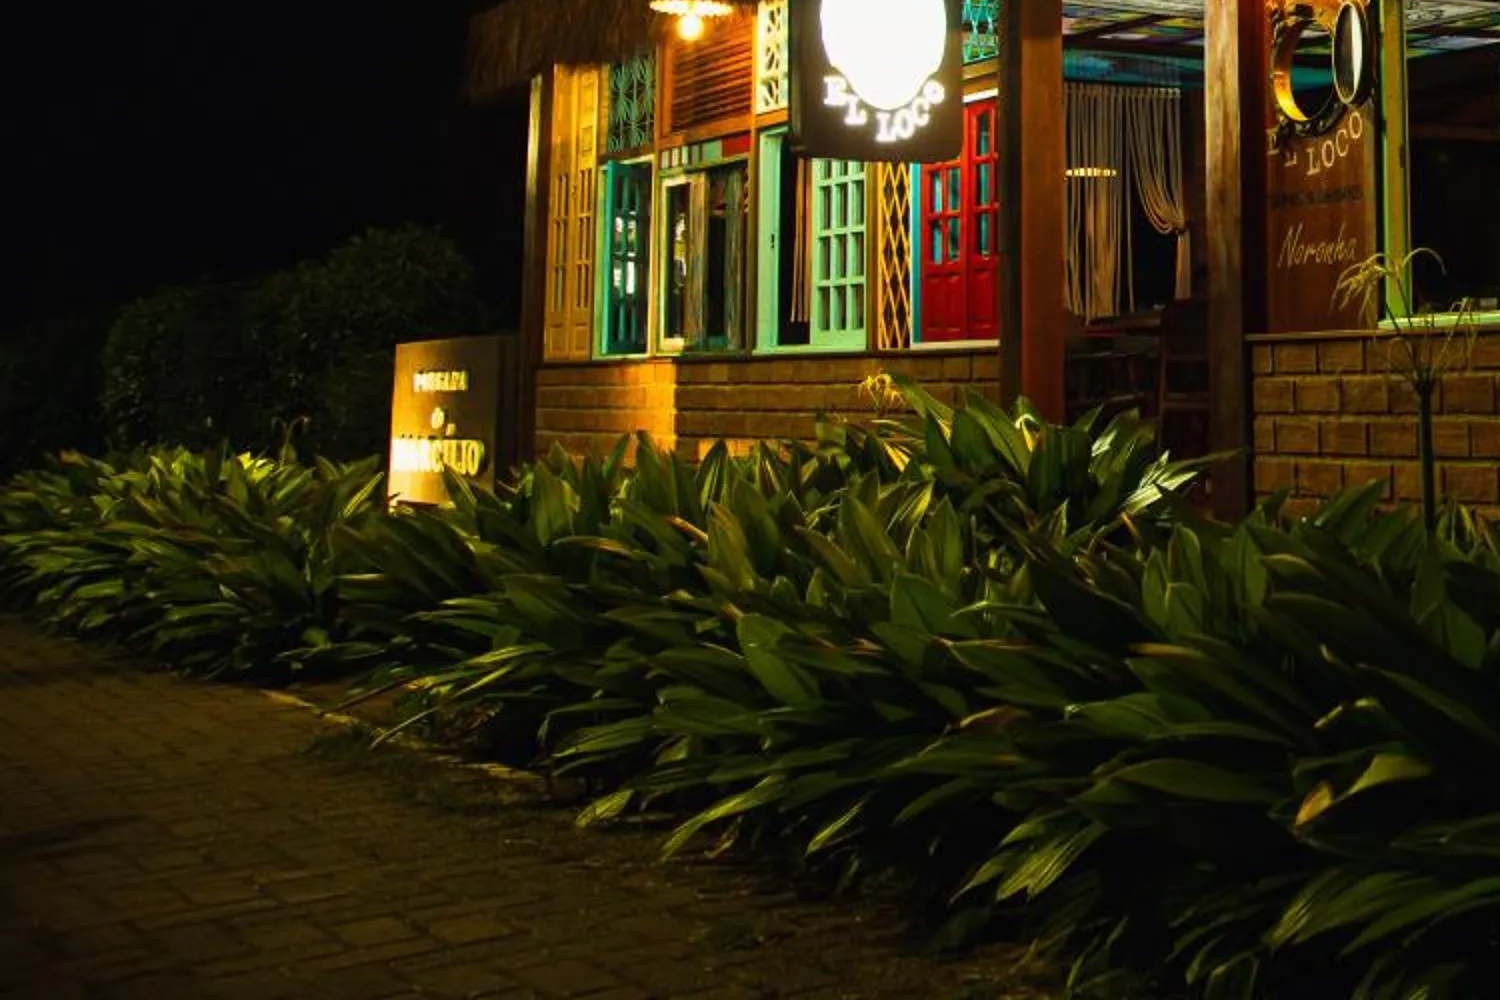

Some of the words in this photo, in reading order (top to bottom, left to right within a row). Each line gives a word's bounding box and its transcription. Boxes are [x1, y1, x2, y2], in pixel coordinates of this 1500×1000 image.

[823, 74, 868, 126] EL
[875, 79, 946, 143] LOCO
[1306, 111, 1364, 176] LOCO
[1277, 220, 1358, 268] Noronha
